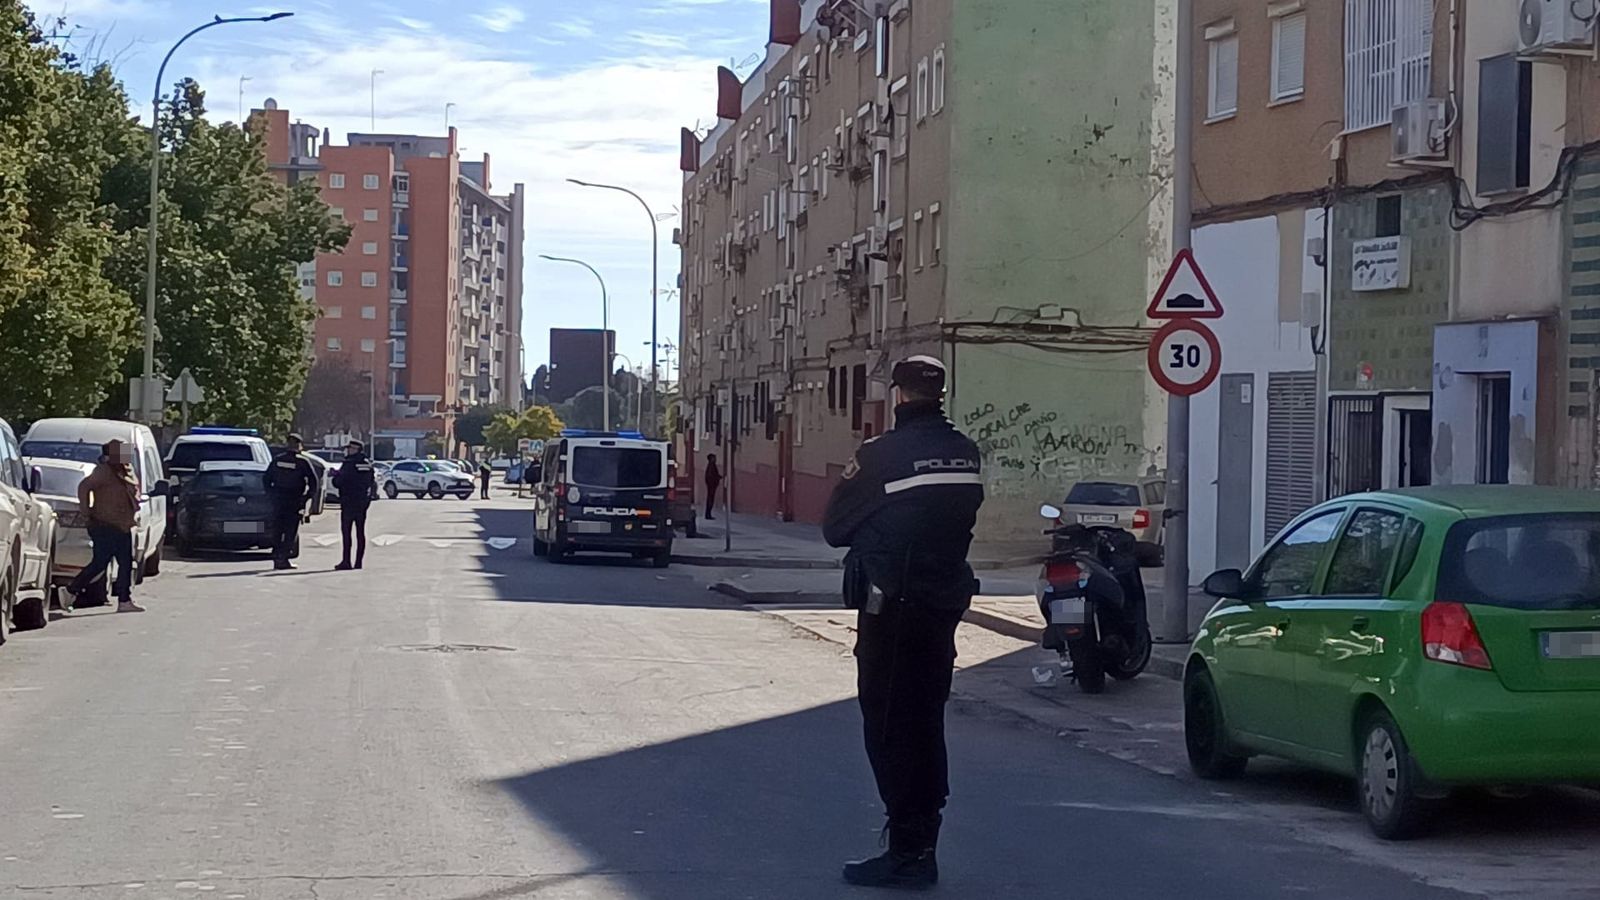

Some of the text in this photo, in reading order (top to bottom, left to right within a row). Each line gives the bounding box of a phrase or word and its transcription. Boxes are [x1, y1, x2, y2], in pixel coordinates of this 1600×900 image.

[1170, 344, 1200, 368] 30
[964, 403, 994, 426] LOLO
[583, 506, 638, 516] POLICIA
